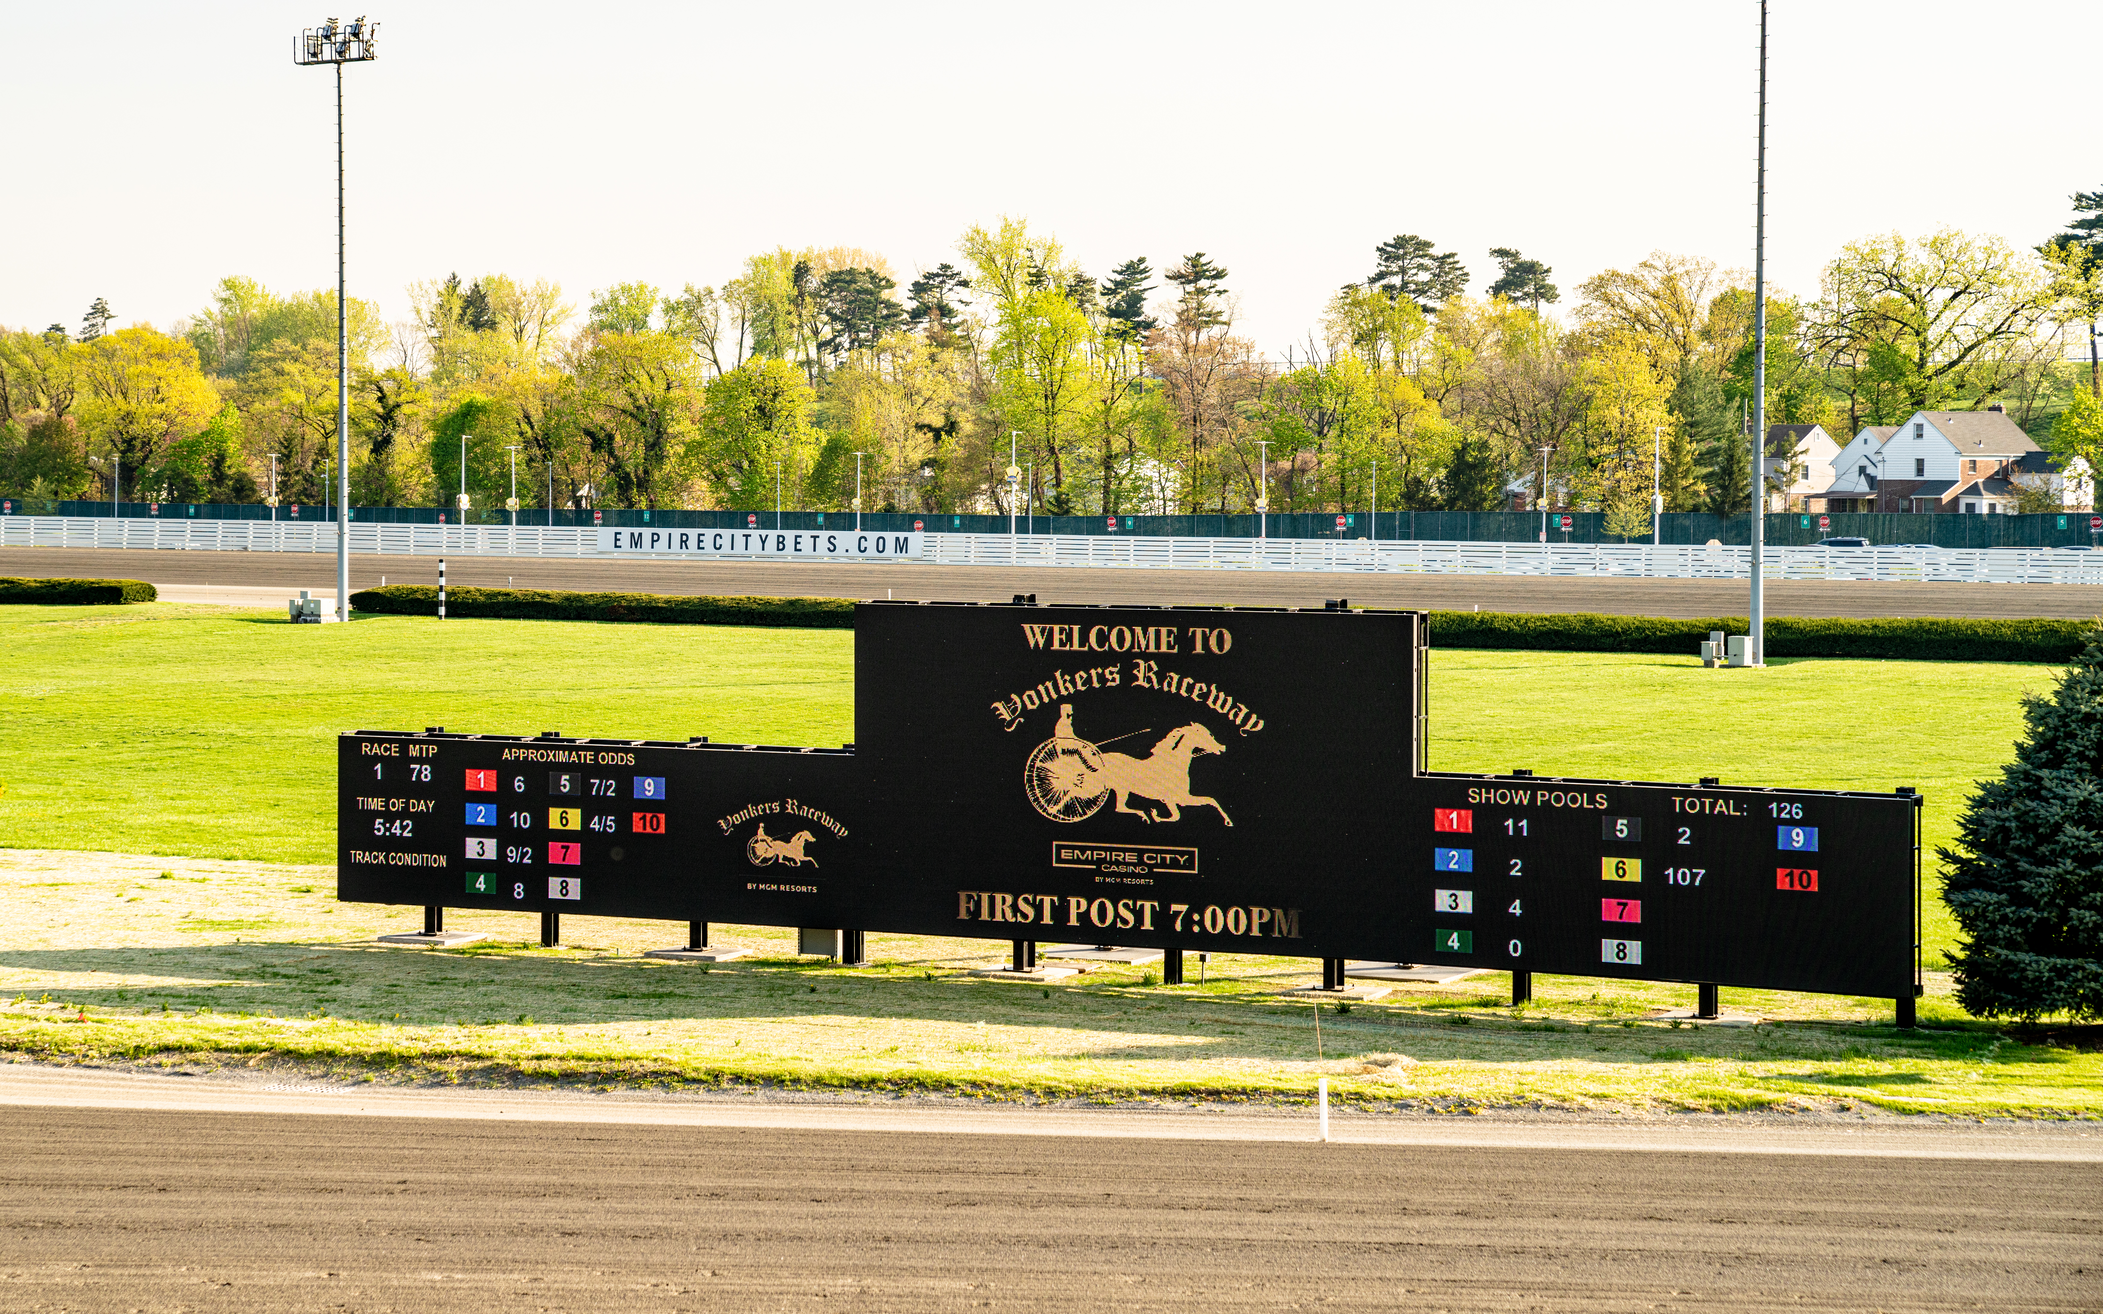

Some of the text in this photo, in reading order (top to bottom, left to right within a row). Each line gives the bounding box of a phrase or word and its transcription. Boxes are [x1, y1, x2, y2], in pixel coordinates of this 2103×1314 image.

[614, 531, 909, 554] EMPIRECITYBETS.COM
[1021, 624, 1232, 654] WELCOME TO
[990, 659, 1265, 737] Yonkers Raceway
[362, 743, 437, 757] RACE MTP
[502, 748, 635, 765] APPROXIMATE ODDS
[374, 763, 431, 782] 1 78
[478, 772, 653, 796] 1 6 5 7/2 9
[356, 797, 435, 812] TIME OF DAY
[1468, 788, 1607, 809] SHOW POOLS
[1672, 797, 1803, 819] TOTAL: 126
[374, 819, 412, 837] 5:42
[477, 806, 660, 833] 2 10 6 4/5 10
[717, 799, 848, 840] Yonkers Raceway
[1450, 811, 1803, 847] 1 11 5 2 9
[350, 851, 446, 867] TRACK CONDITION
[477, 841, 570, 863] 3 9/2 7
[1061, 849, 1189, 865] EMPIRE CITY
[1101, 864, 1148, 873] CASINO
[1449, 851, 1812, 889] 2 2 6 107 10
[476, 875, 569, 899] 4 8 8
[957, 891, 1303, 938] FIRST POST 7:00PM
[1447, 893, 1628, 921] 3 4 7
[1448, 932, 1627, 961] 4 0 8
